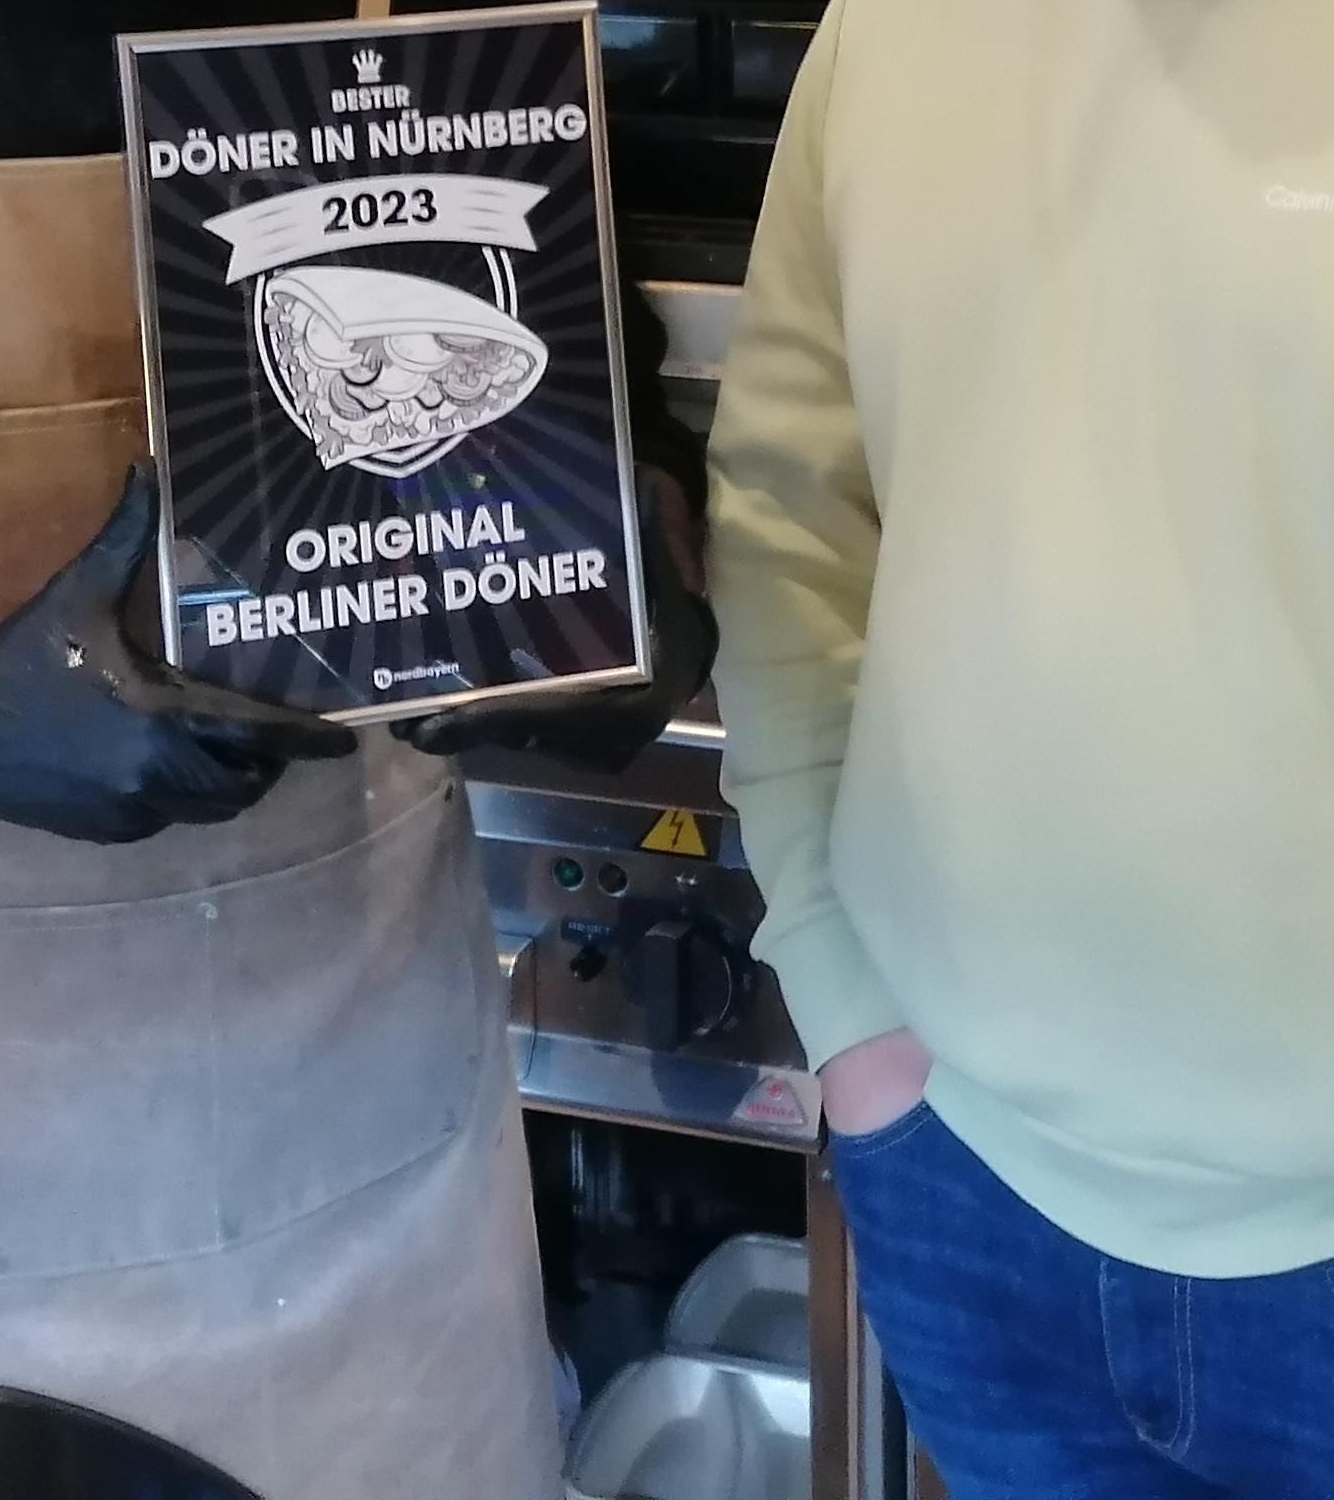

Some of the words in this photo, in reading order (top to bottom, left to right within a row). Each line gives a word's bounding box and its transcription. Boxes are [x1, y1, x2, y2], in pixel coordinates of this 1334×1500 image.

[331, 83, 411, 113] BESTER
[149, 128, 301, 180] DÖNER
[311, 124, 356, 164] IN
[369, 101, 588, 159] NÜRNBERG
[322, 189, 439, 235] 2023
[1265, 184, 1331, 213] Calvin
[285, 500, 526, 574] ORIGINAL
[207, 576, 429, 647] BERLINER
[442, 548, 607, 612] DÖNER
[393, 660, 460, 682] nordbayern
